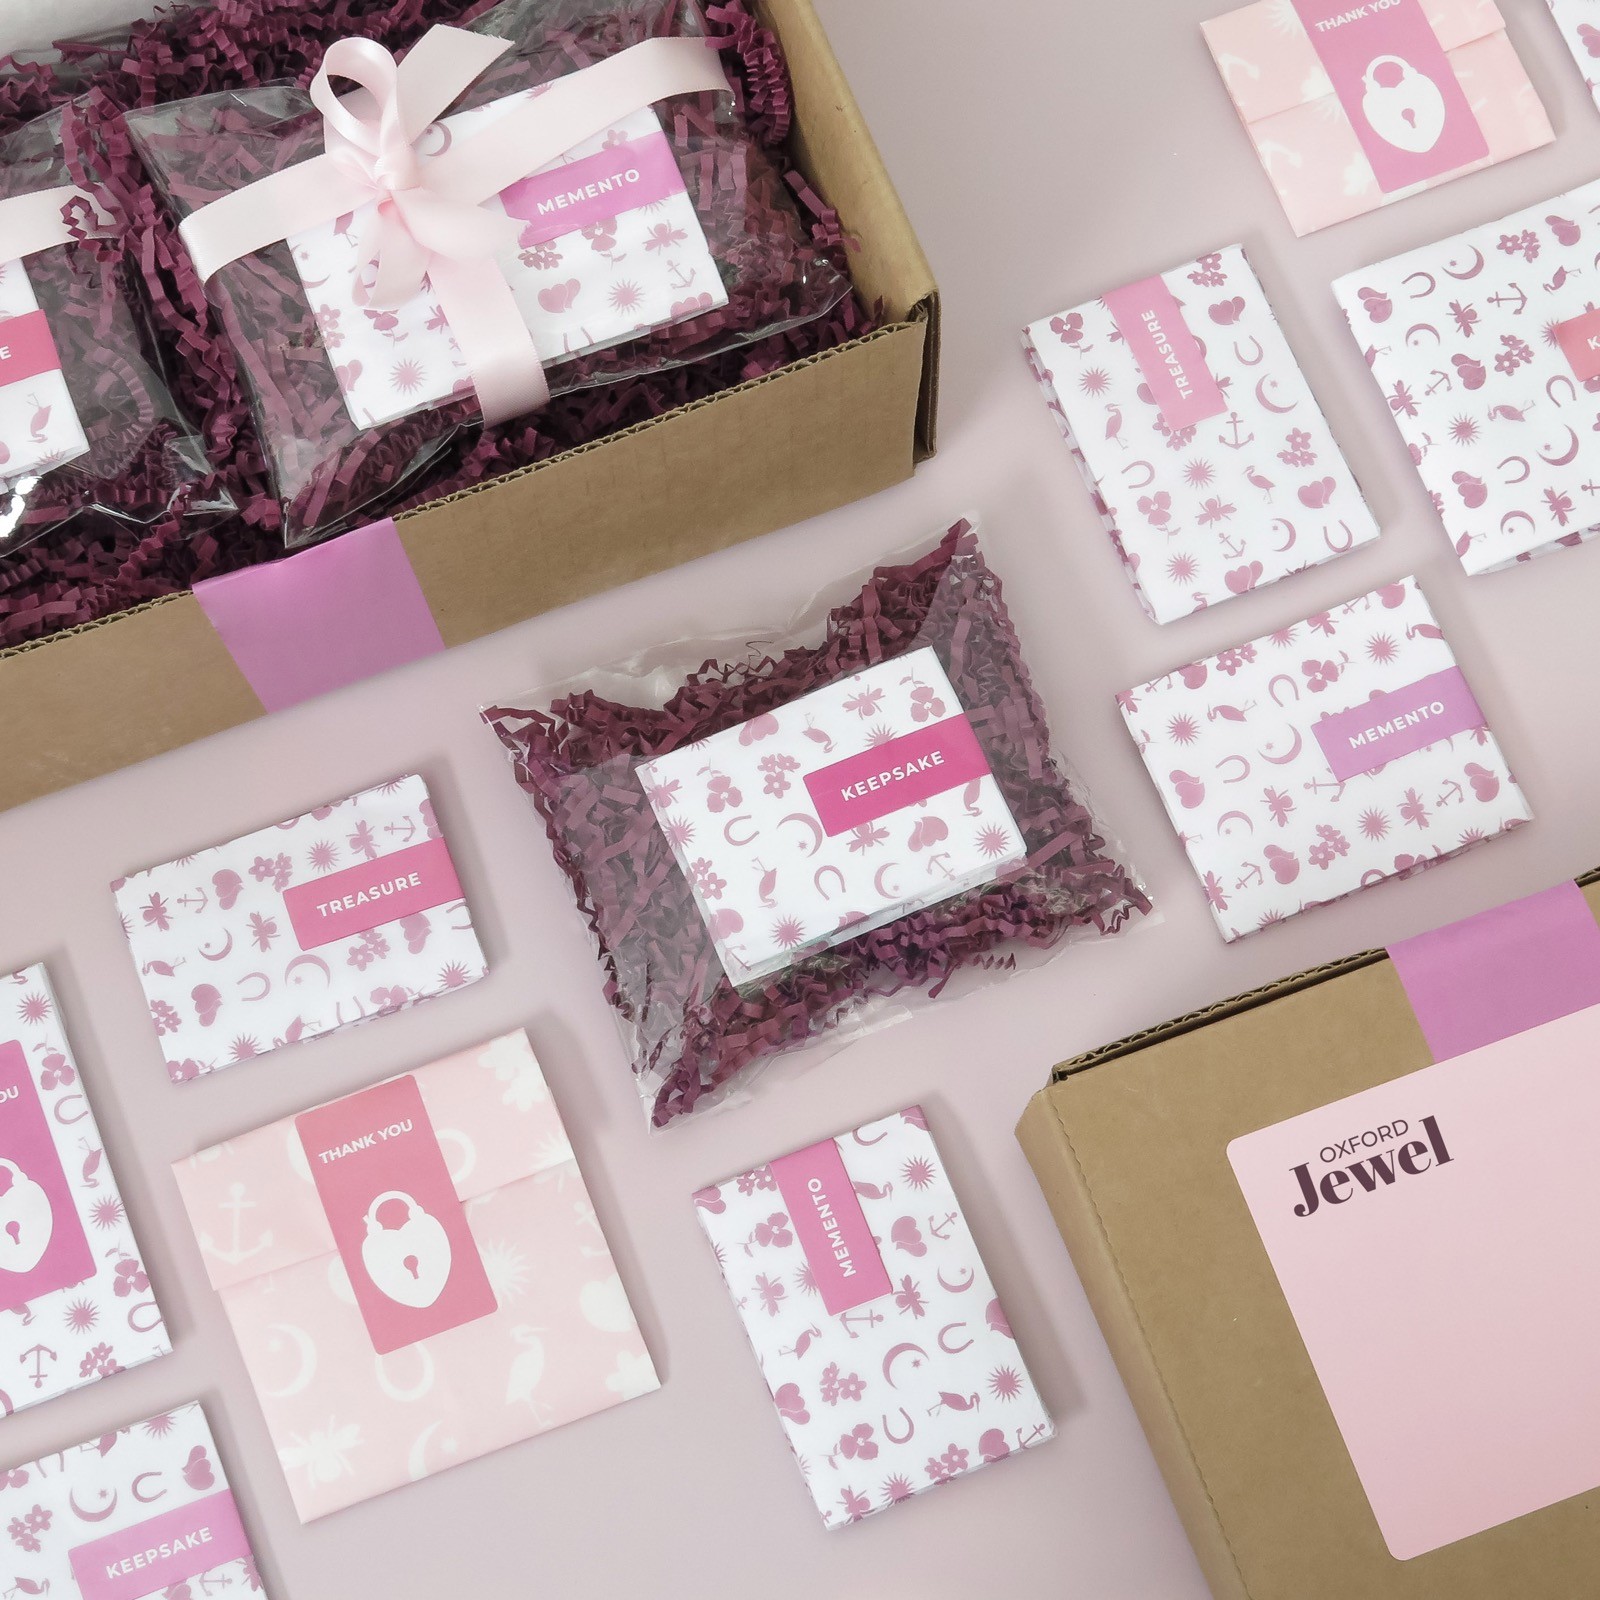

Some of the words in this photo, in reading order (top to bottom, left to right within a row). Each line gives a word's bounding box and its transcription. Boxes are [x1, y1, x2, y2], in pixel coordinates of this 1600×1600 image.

[1315, 6, 1369, 32] THANK
[537, 169, 640, 215] MEMENTO
[1141, 309, 1194, 400] TREASURE
[1348, 701, 1445, 749] MEMENTO
[840, 750, 945, 802] KEEPSAKE
[316, 872, 422, 917] TREASURE
[318, 1132, 377, 1164] THANK
[377, 1118, 413, 1141] YOU
[1319, 1119, 1409, 1163] OXFORD
[1288, 1114, 1455, 1218] Jewel
[807, 1178, 857, 1278] MEMENTO
[105, 1526, 213, 1580] KEEPSAKE
